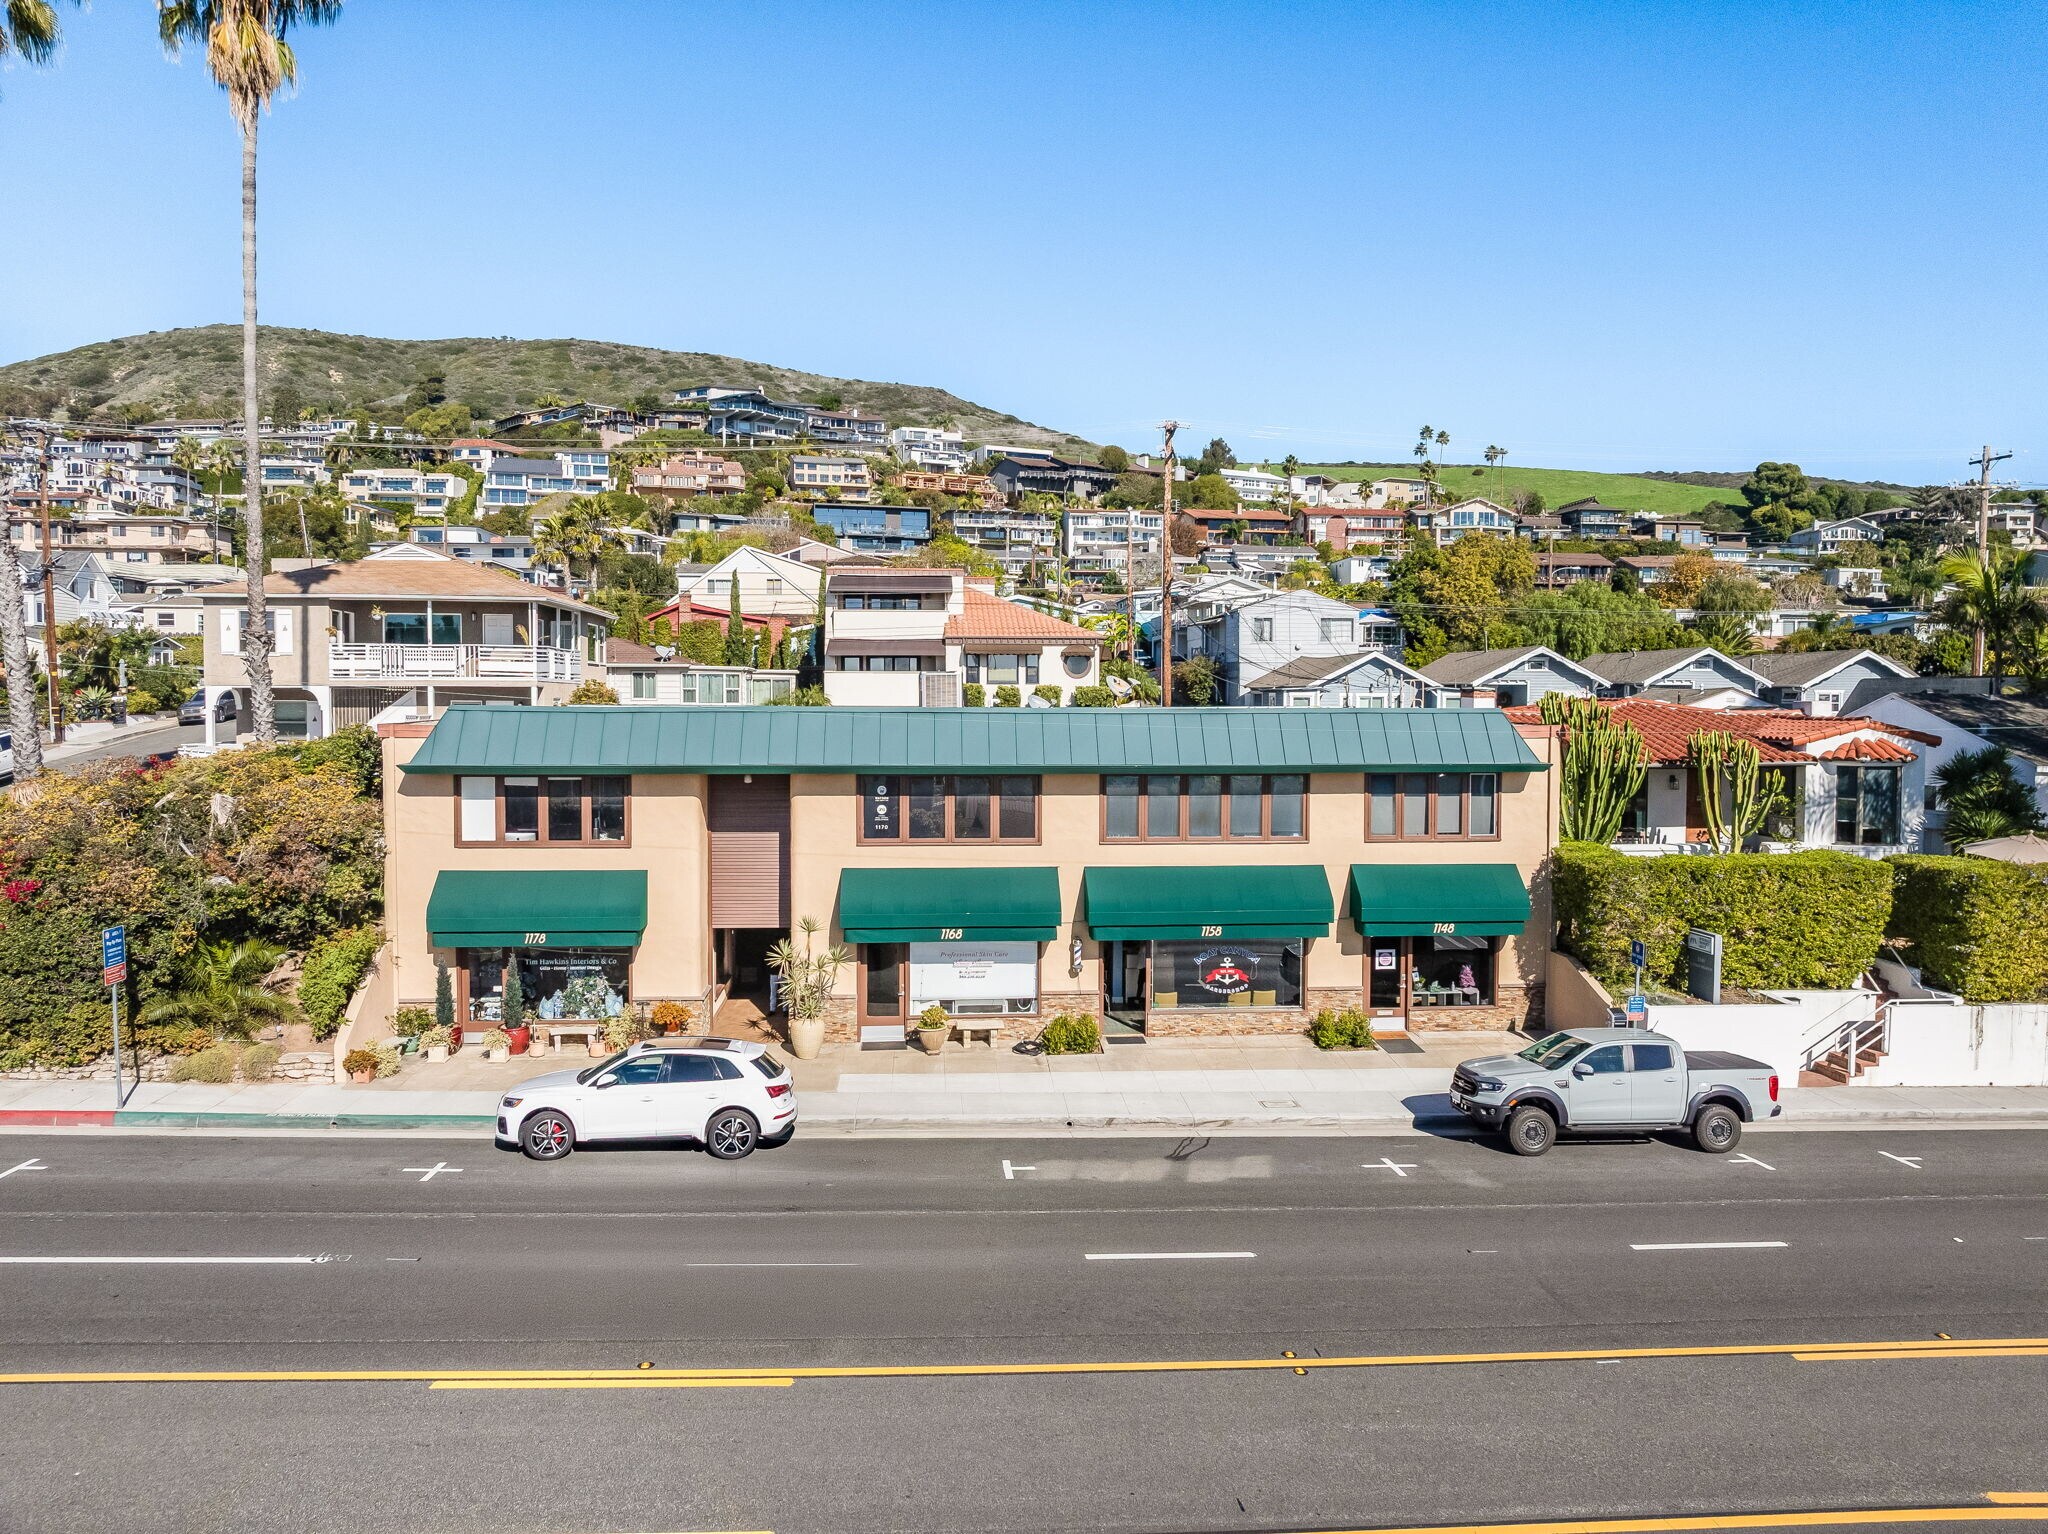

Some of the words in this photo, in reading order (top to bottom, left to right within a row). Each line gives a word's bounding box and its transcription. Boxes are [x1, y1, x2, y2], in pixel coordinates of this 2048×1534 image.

[940, 928, 963, 940] 1168
[1201, 926, 1222, 937] 1158
[1433, 923, 1455, 934] 1148
[524, 932, 546, 944] 1178
[940, 951, 978, 959] Professional
[570, 958, 600, 966] Interiors
[600, 957, 607, 965] &
[1205, 983, 1249, 994] BARBERSHOP
